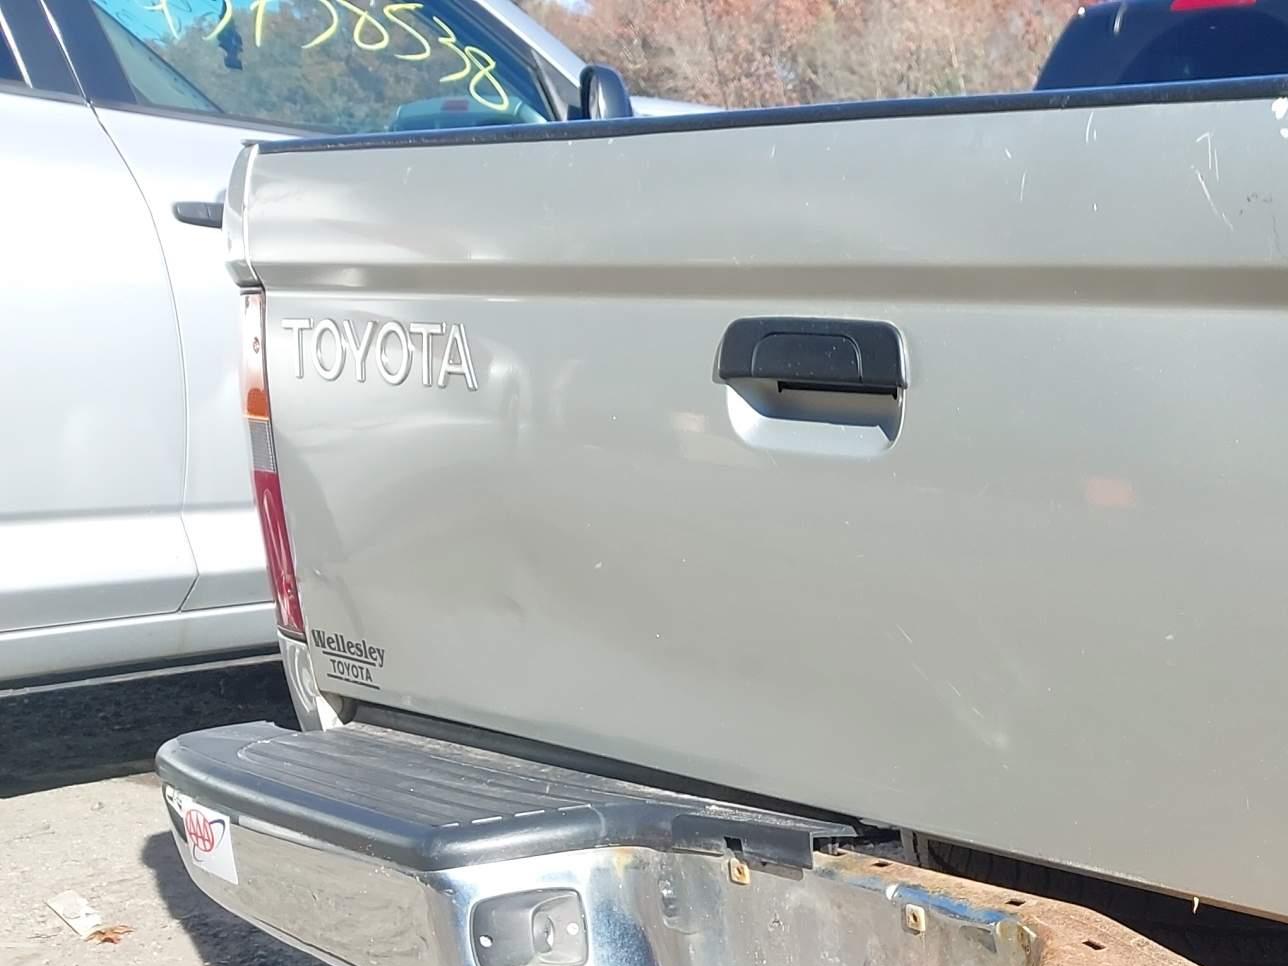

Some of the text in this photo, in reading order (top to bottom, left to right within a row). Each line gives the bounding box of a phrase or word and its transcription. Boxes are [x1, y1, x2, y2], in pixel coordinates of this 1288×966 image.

[281, 318, 479, 392] TOYOTA
[311, 629, 385, 668] Wellesley
[329, 658, 373, 682] TOYOTA
[186, 810, 214, 852] AAA
